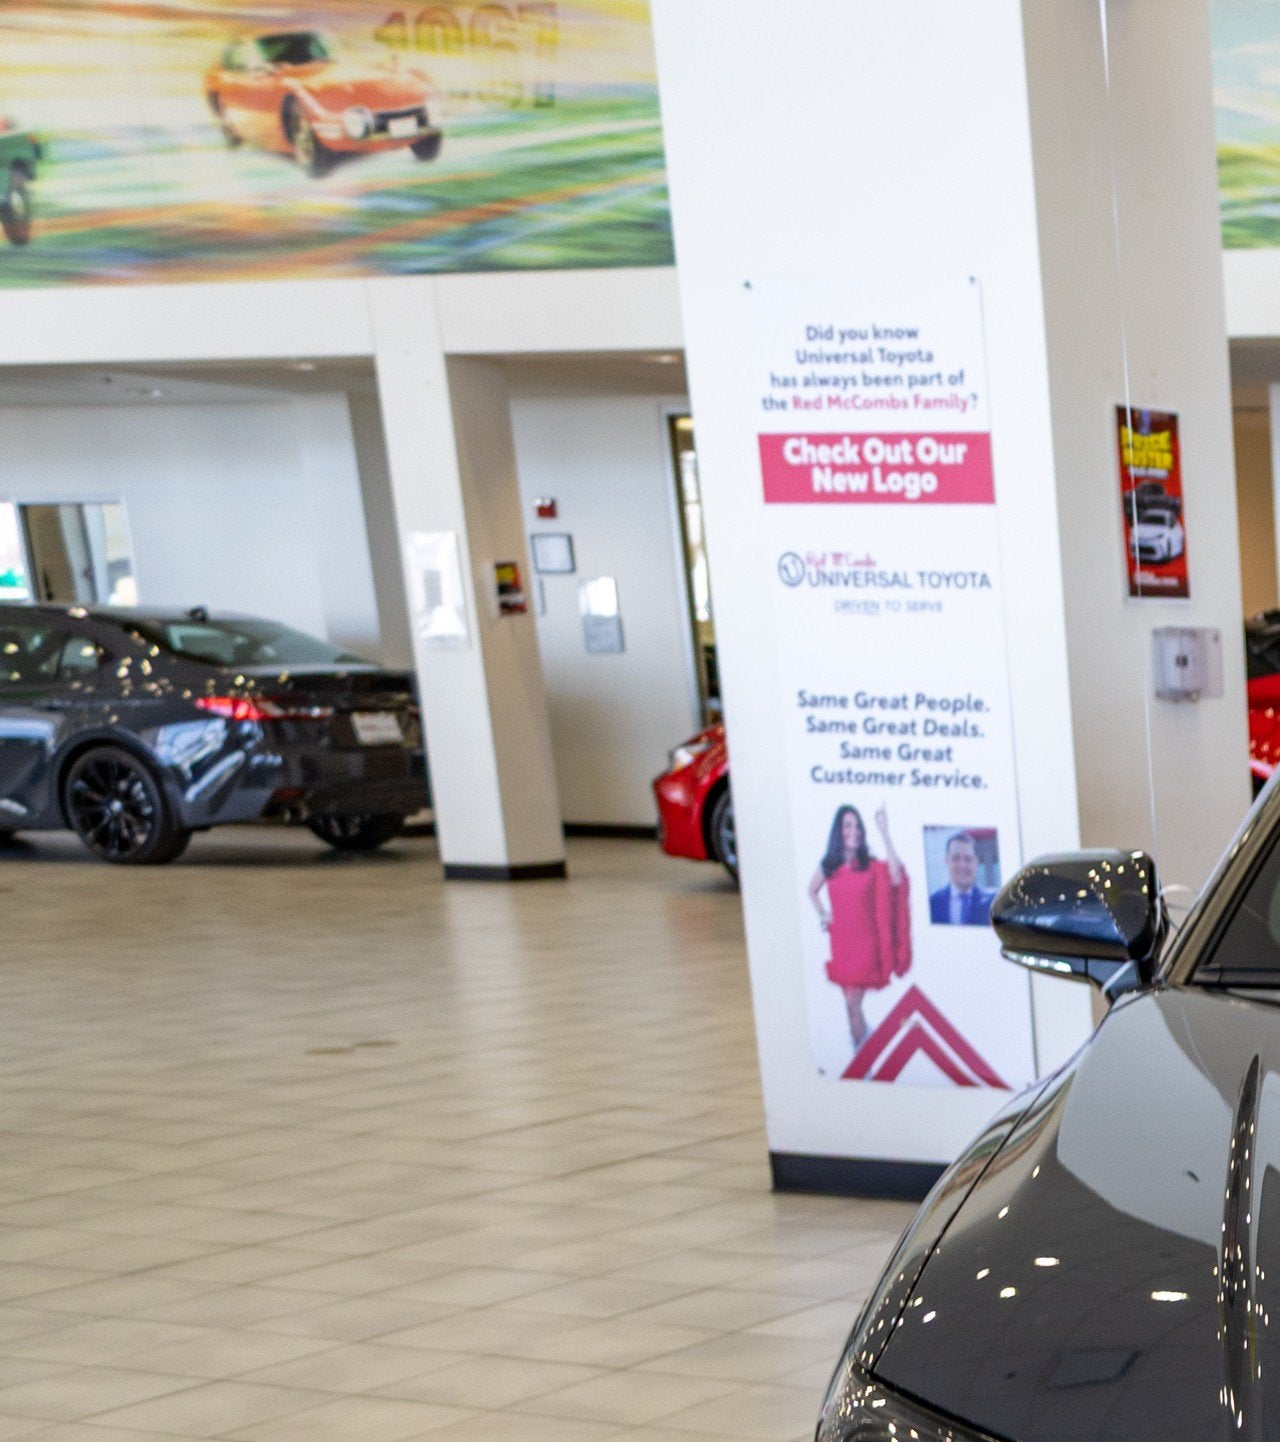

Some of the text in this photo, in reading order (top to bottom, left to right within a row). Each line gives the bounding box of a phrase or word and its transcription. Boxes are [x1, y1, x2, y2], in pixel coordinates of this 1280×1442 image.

[805, 324, 919, 344] Did you know
[795, 348, 934, 366] Universal Toyota
[770, 369, 965, 390] has always been part of
[761, 393, 978, 413] the Red McCombs Family?
[783, 437, 968, 466] Check Out Our
[811, 467, 939, 500] New Logo
[807, 571, 992, 589] UNIVERSAL TOYOTA
[834, 600, 880, 615] DRIVEN
[884, 600, 902, 613] TO
[797, 690, 990, 715] Same Great People.
[805, 717, 985, 738] Same Great Deals.
[839, 742, 954, 763] Same Great
[810, 766, 989, 790] Customer Service.
